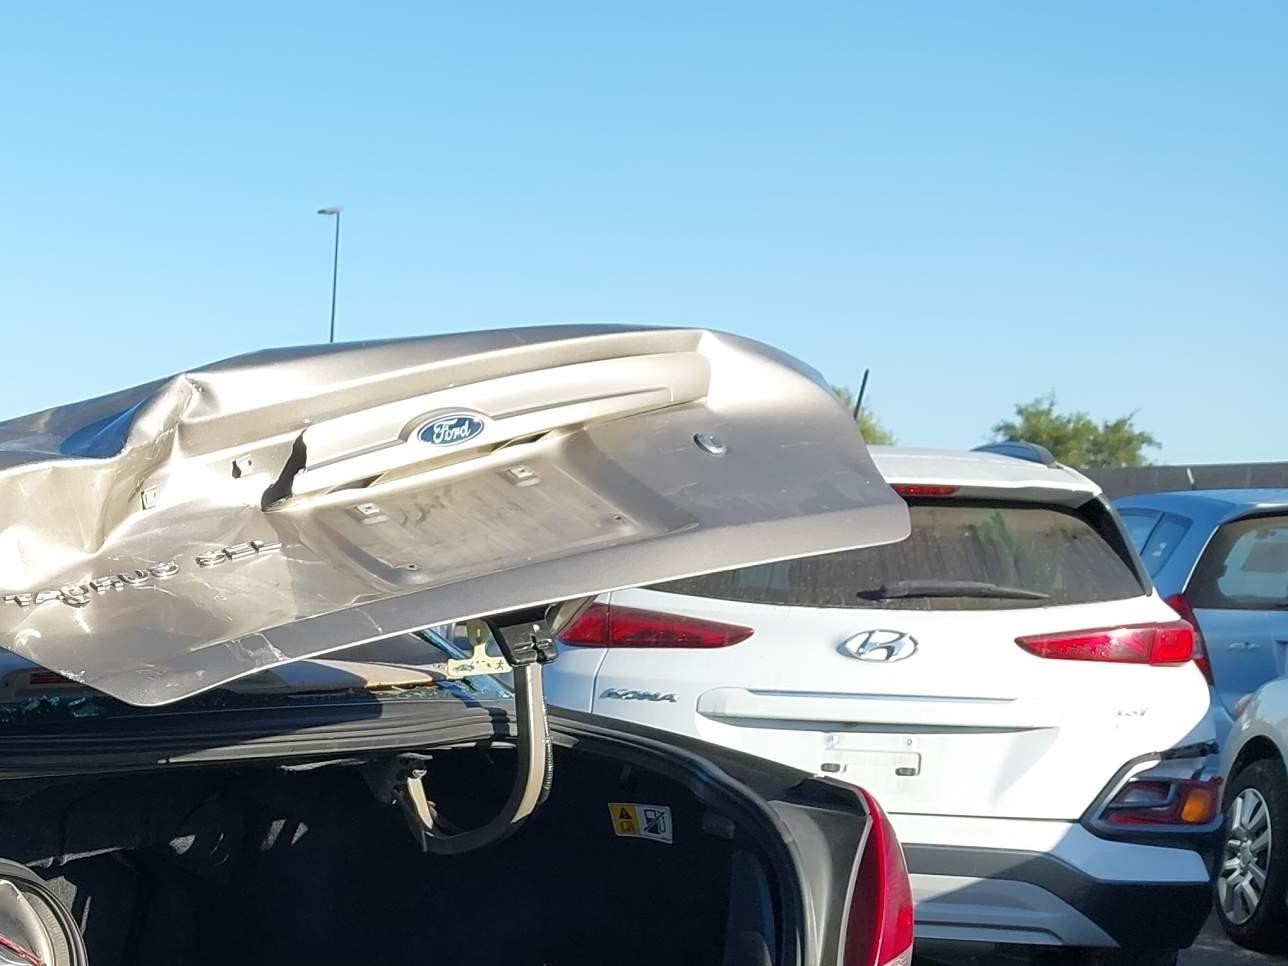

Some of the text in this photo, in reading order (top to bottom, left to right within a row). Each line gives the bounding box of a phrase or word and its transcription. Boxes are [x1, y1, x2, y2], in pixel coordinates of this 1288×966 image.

[432, 417, 472, 444] Ford
[3, 539, 282, 608] TAURUS SEL
